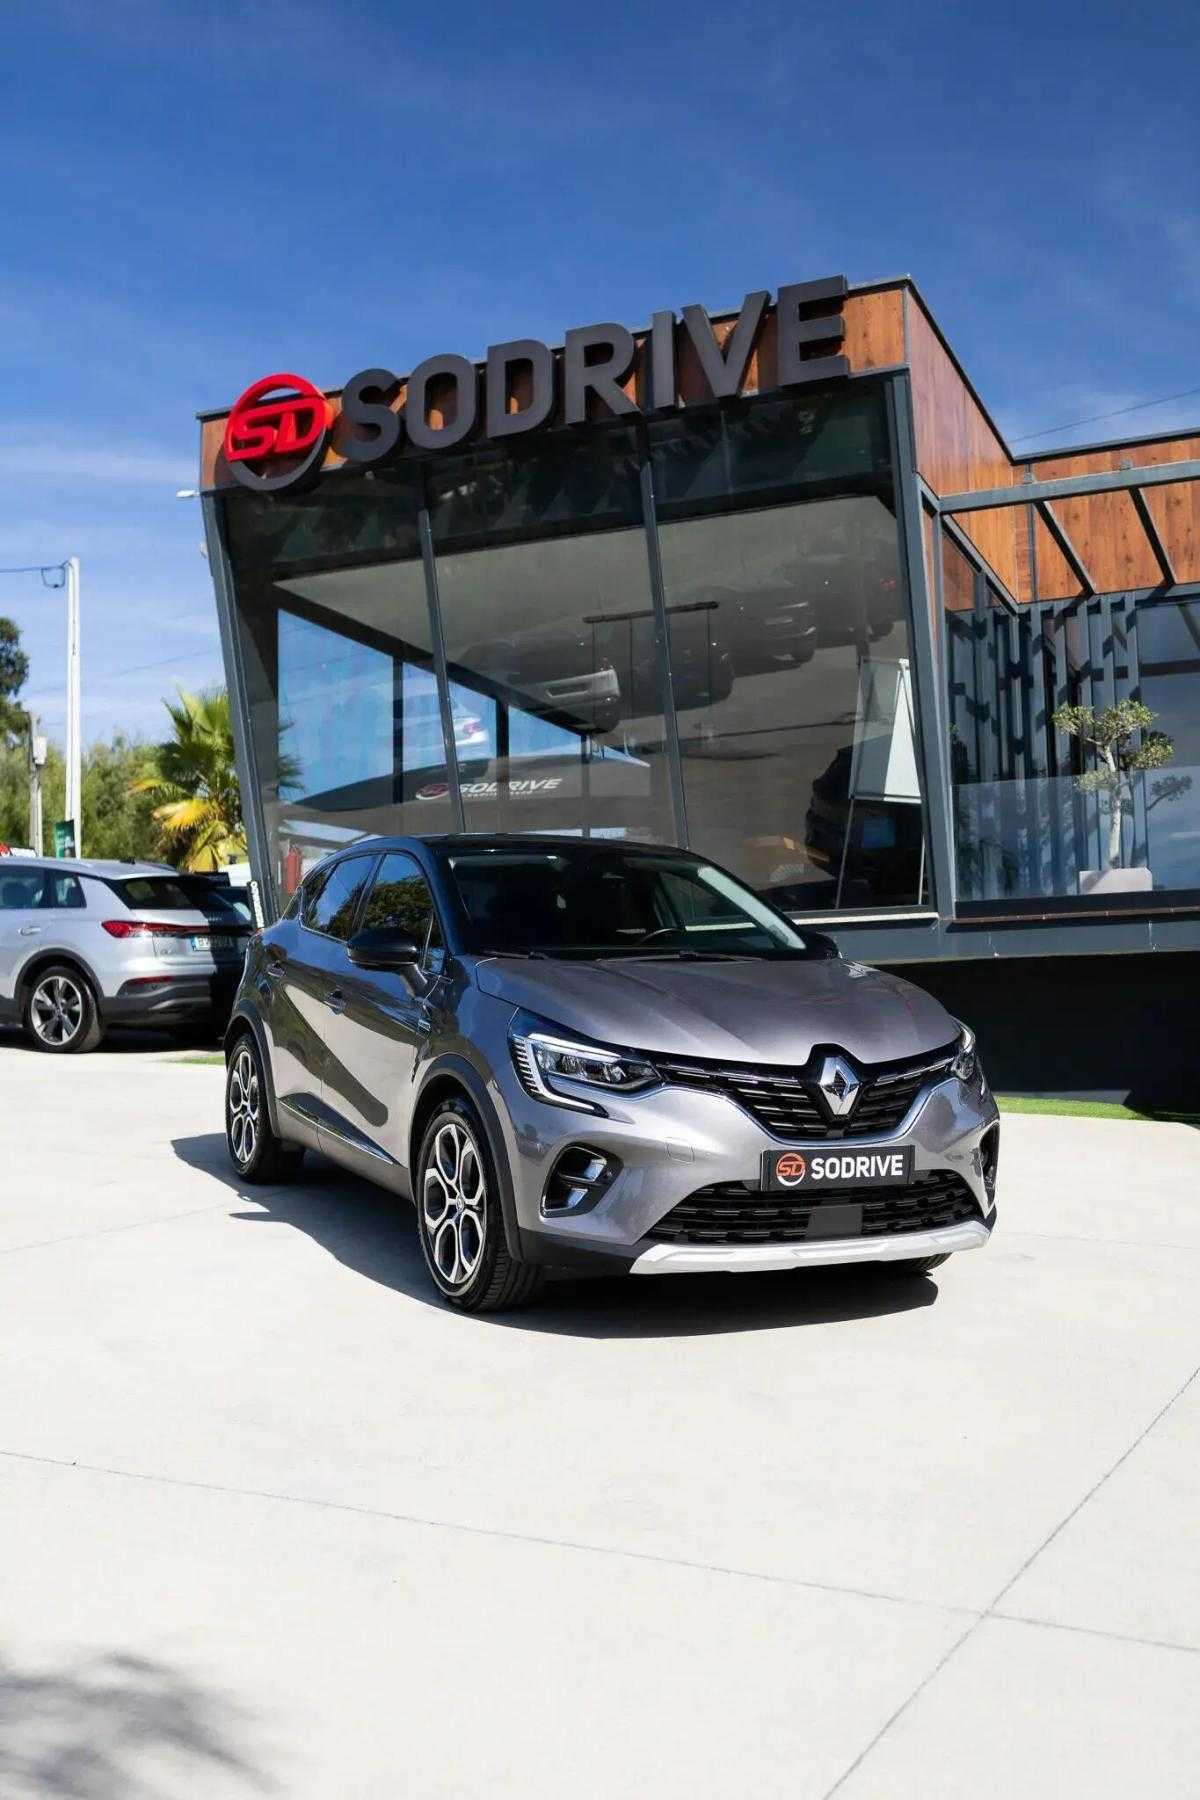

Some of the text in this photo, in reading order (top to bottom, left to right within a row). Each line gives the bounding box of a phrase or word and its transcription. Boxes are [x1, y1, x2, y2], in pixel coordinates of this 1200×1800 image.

[225, 275, 849, 463] SD SODRIVE
[810, 1154, 904, 1180] SODRIVE
